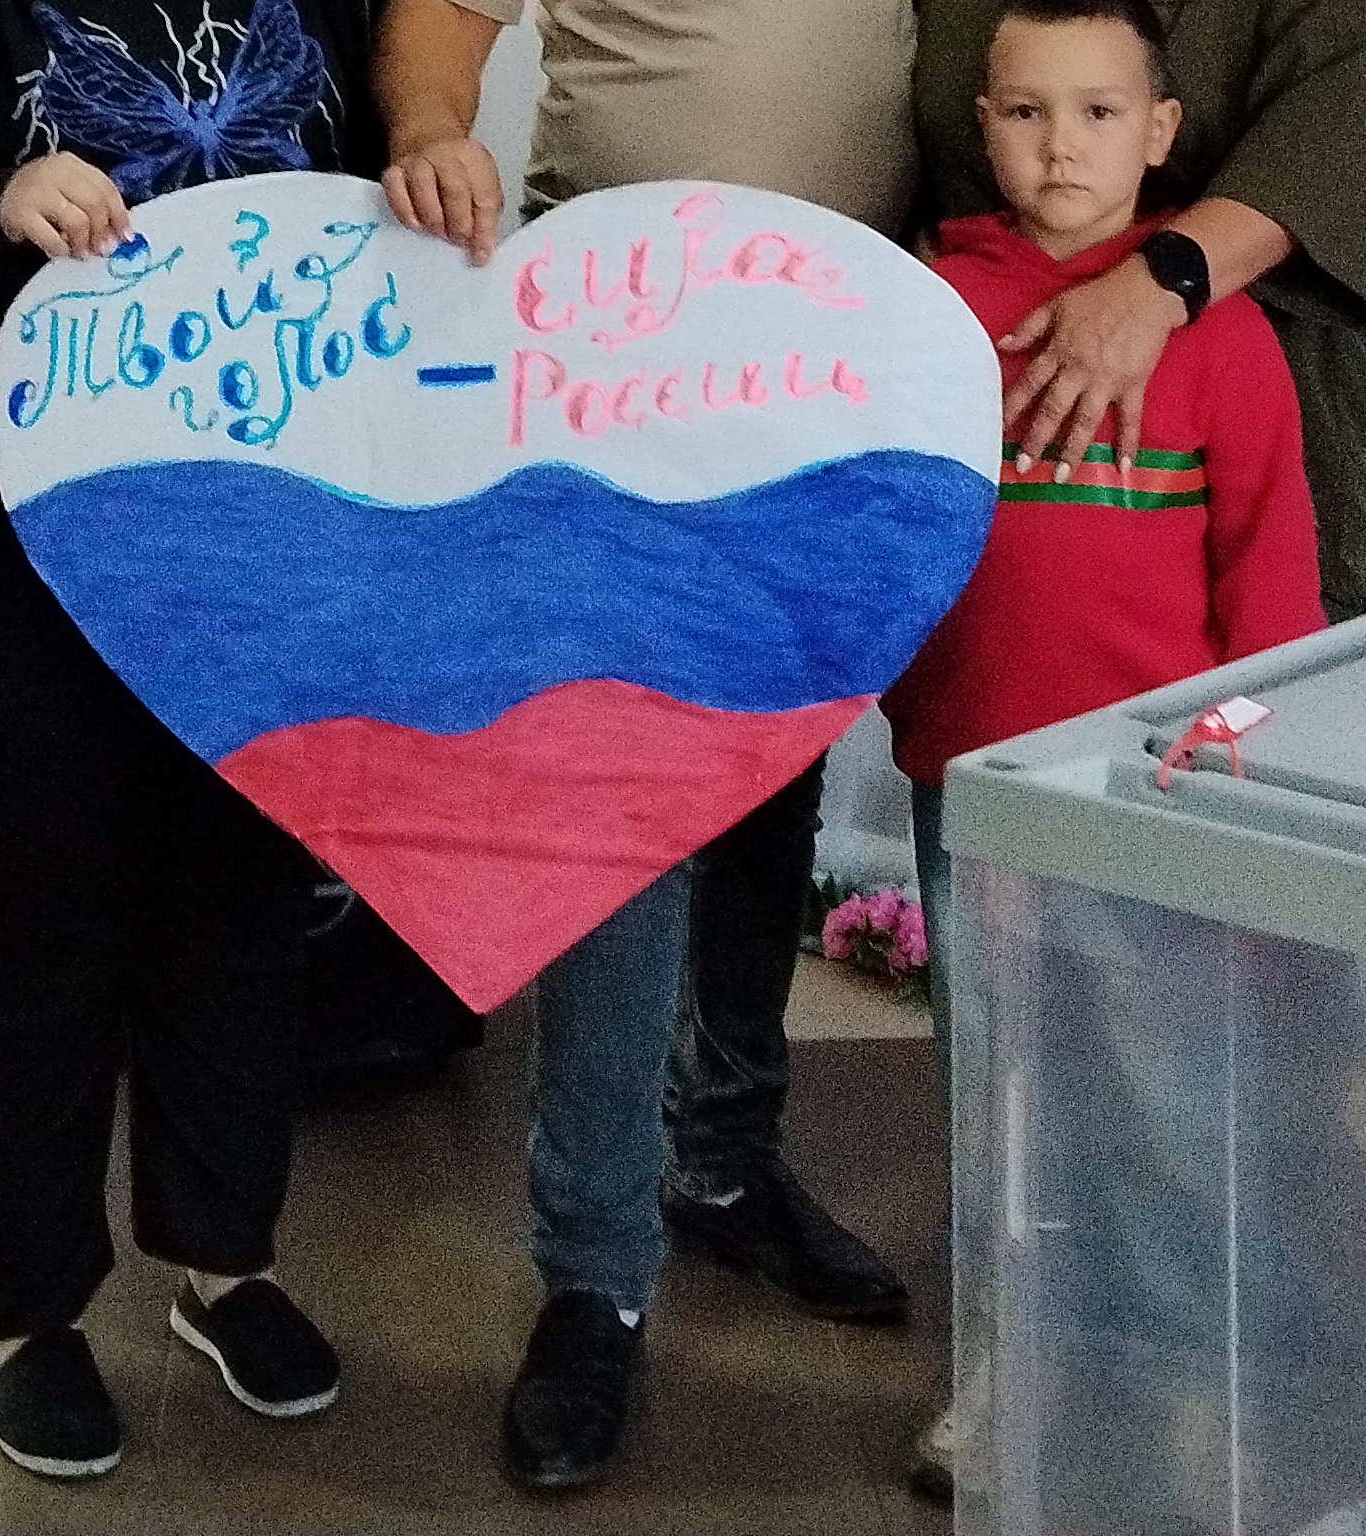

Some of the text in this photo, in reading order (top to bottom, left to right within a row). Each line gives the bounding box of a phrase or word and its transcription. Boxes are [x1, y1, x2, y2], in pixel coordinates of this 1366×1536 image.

[8, 209, 283, 428] Твой
[169, 221, 412, 449] голос
[508, 347, 869, 449] России
